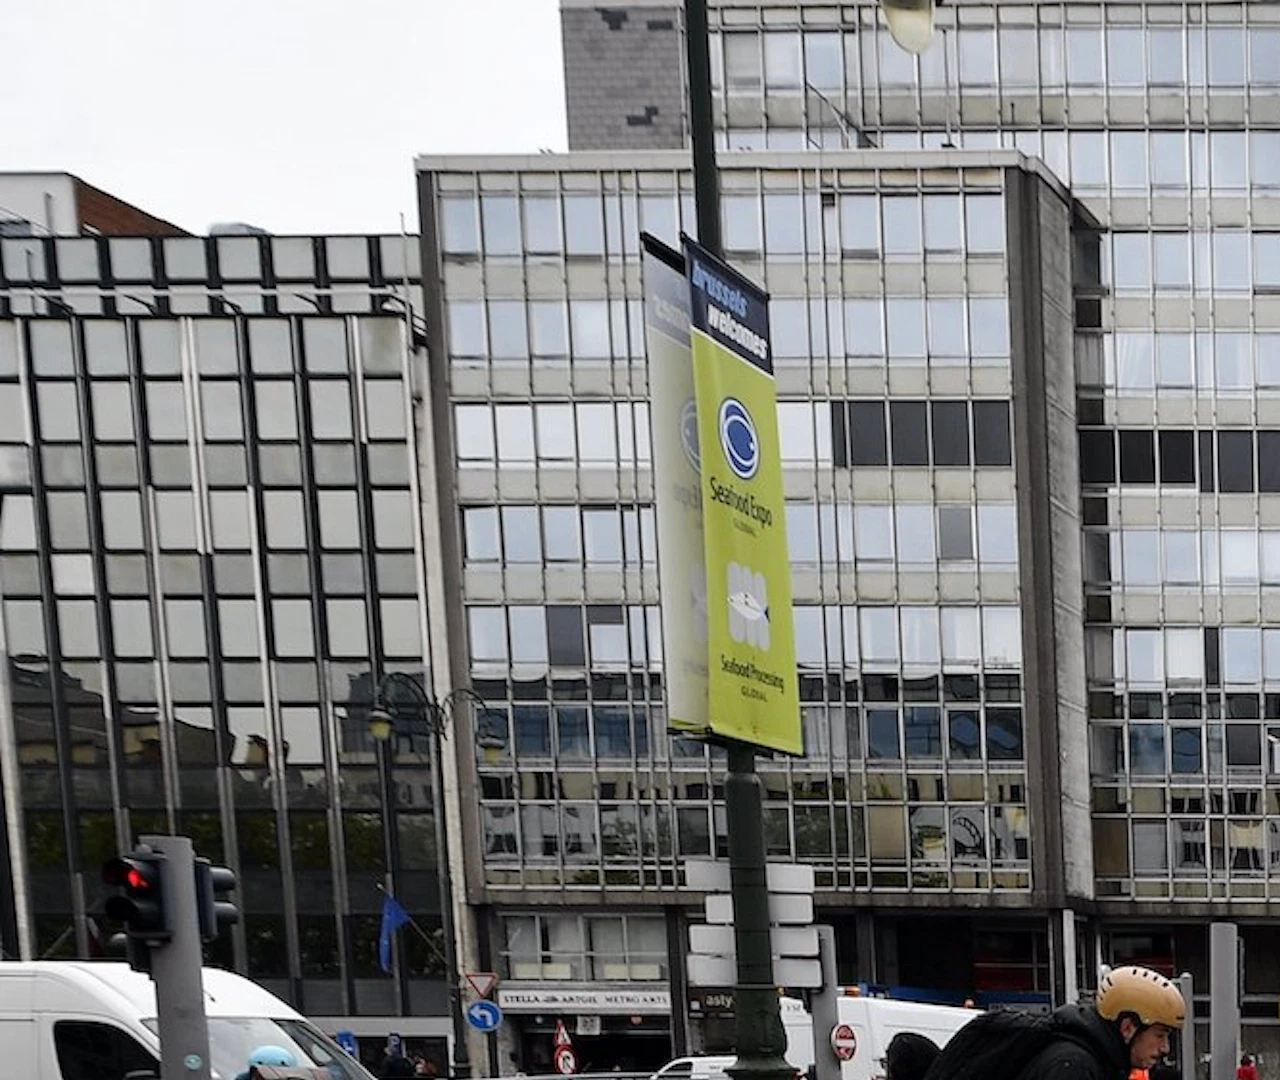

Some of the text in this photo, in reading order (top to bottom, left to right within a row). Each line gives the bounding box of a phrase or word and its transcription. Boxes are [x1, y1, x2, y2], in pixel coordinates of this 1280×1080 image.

[692, 260, 748, 318] brussels
[708, 303, 768, 360] welcomes
[711, 476, 772, 529] Seafood Expo
[721, 654, 749, 679] Seafood
[748, 661, 784, 694] Processing
[504, 995, 540, 1003] STELLA
